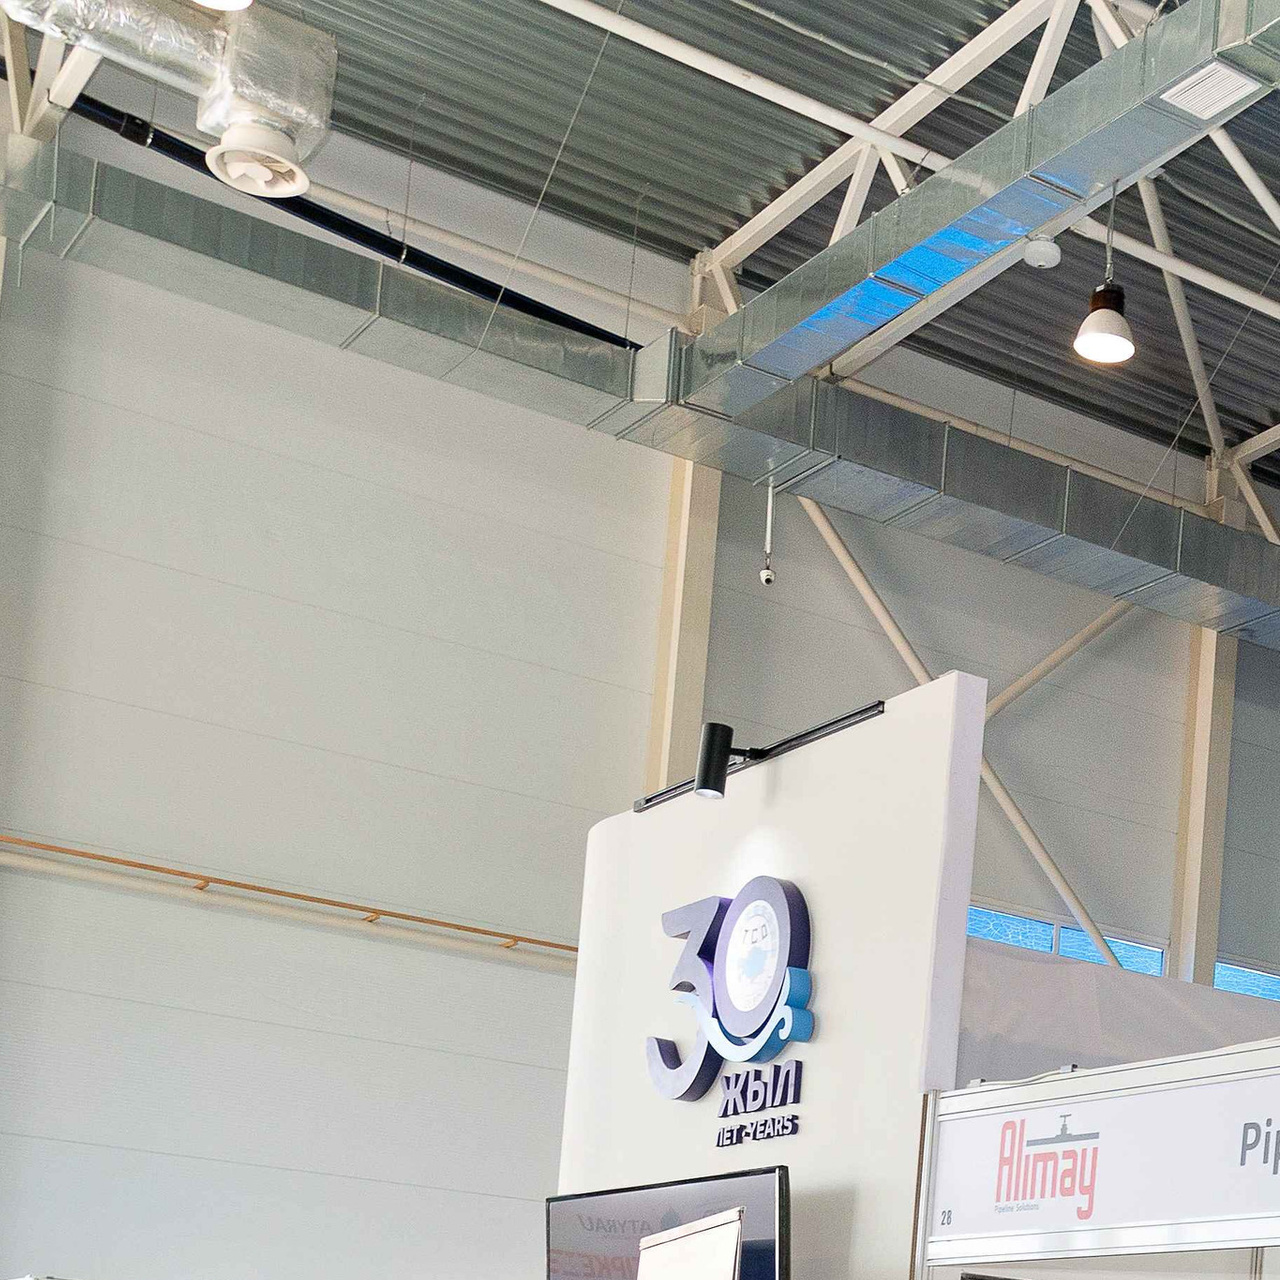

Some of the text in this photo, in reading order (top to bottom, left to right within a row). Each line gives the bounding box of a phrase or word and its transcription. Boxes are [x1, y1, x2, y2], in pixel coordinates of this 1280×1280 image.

[718, 1059, 803, 1118] ЖЫЛ
[995, 1119, 1099, 1220] Alimay
[941, 1210, 952, 1226] 28
